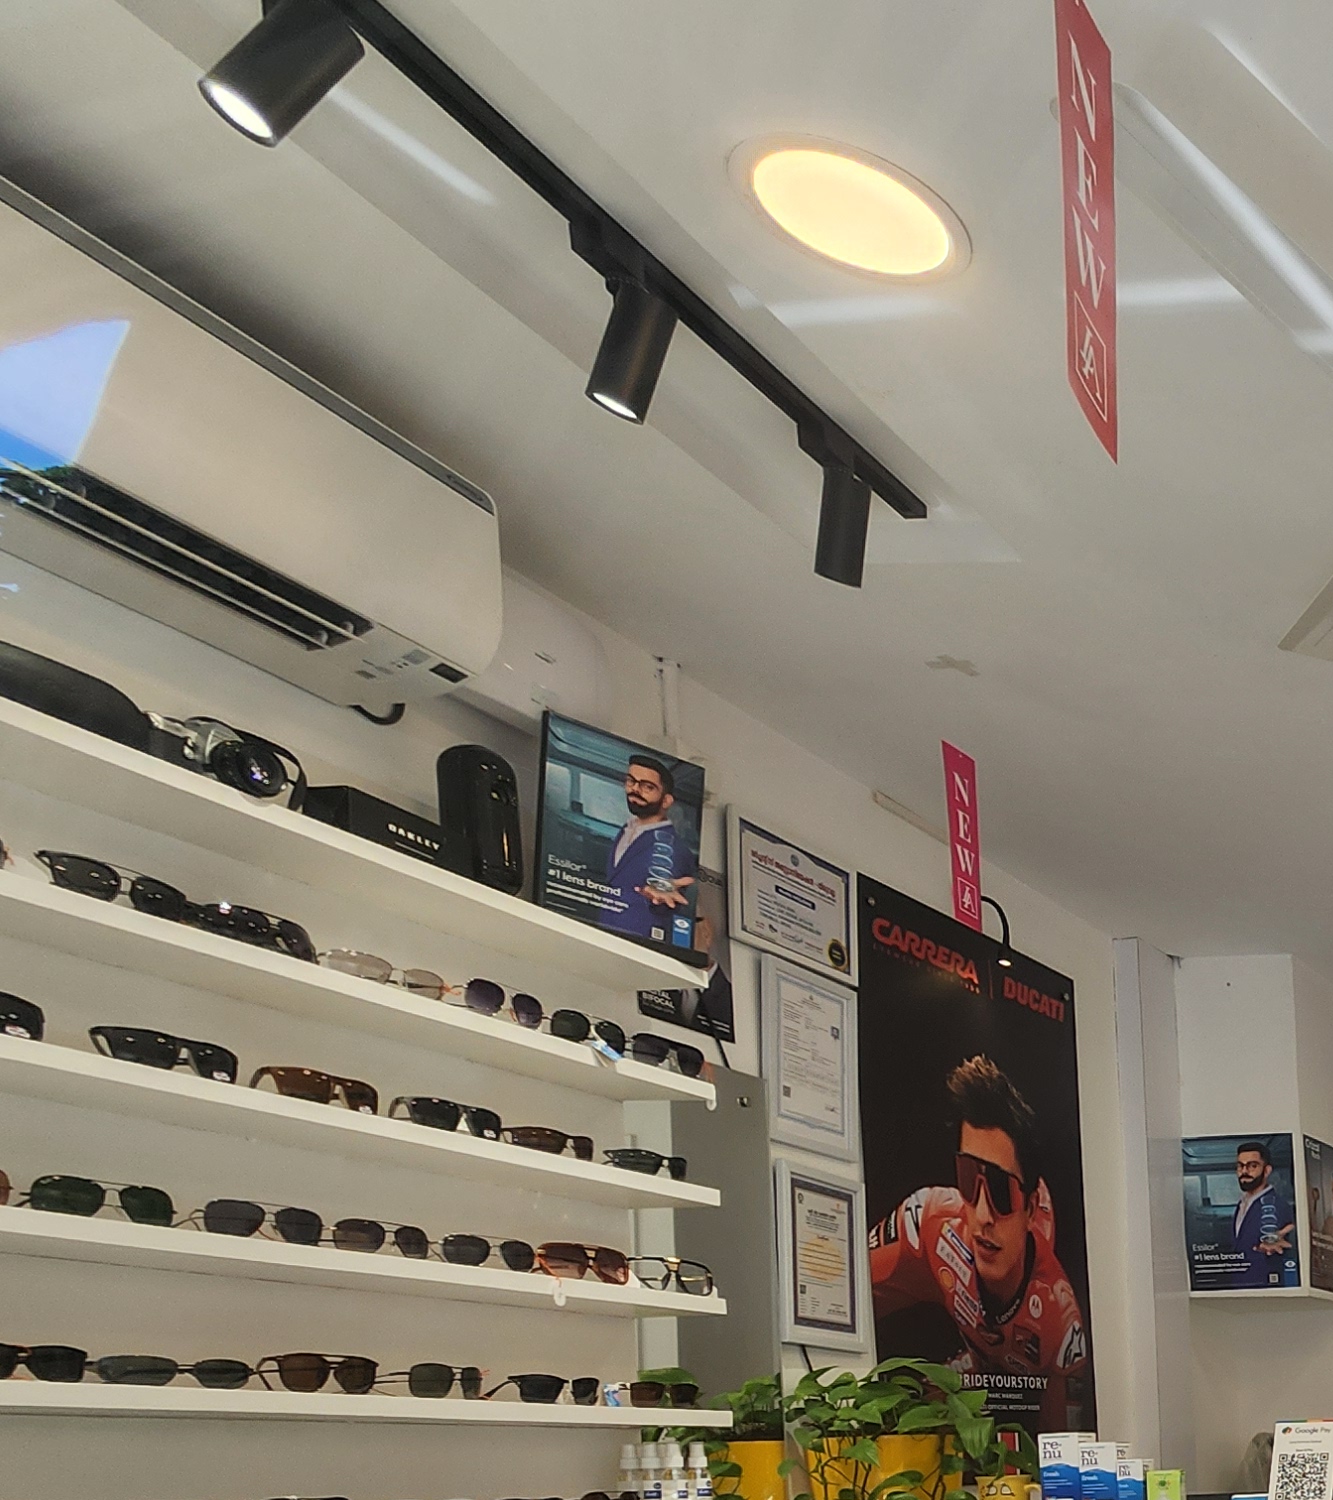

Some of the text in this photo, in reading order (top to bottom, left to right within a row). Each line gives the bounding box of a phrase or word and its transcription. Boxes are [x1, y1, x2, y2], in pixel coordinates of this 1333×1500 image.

[1067, 30, 1107, 310] NEW
[387, 822, 440, 851] OAKLEY
[953, 771, 975, 877] NEW
[563, 869, 586, 890] lens
[587, 876, 622, 898] brand
[871, 917, 1065, 1023] CARRERA DUCATI
[1203, 1252, 1219, 1261] lens
[1220, 1252, 1244, 1260] brand
[1294, 1426, 1332, 1436] Google Pay
[1042, 1450, 1062, 1459] nu
[1081, 1458, 1099, 1466] nu
